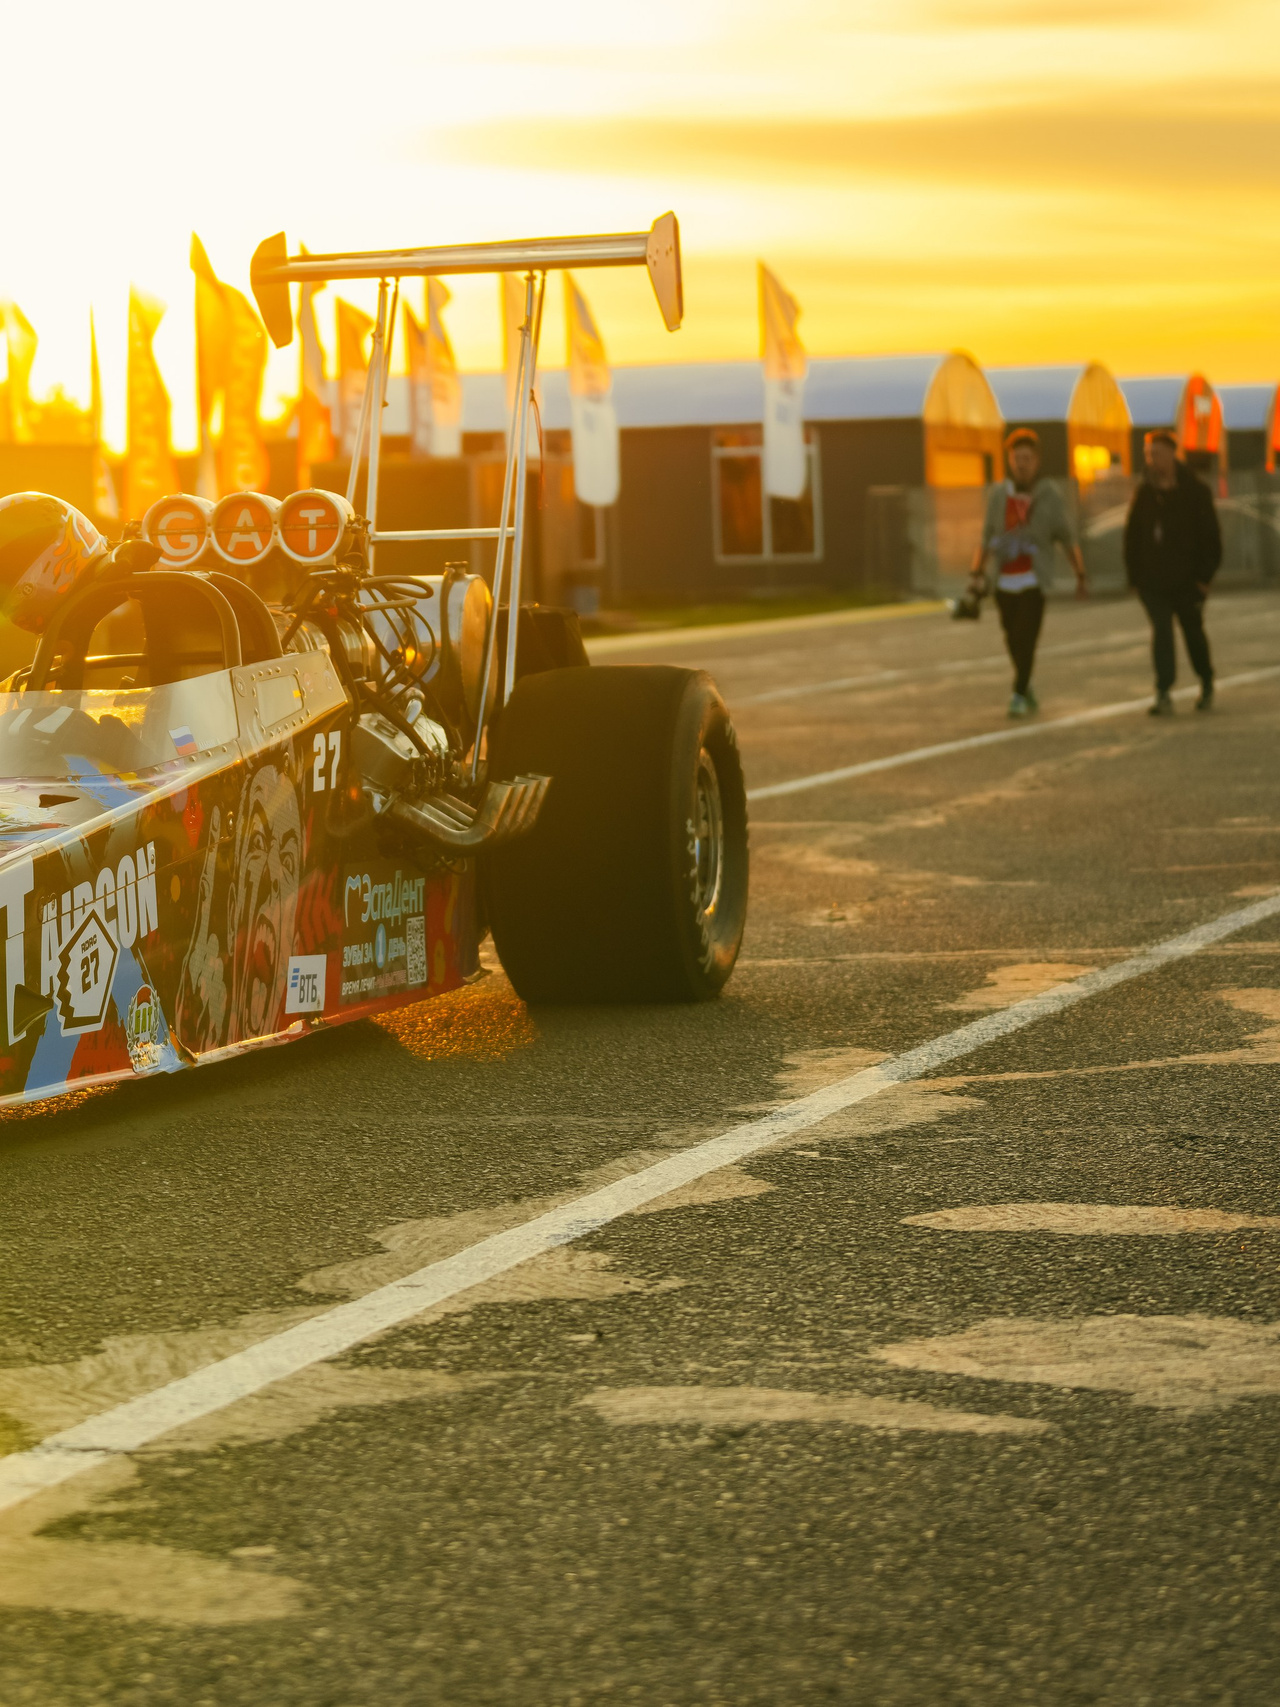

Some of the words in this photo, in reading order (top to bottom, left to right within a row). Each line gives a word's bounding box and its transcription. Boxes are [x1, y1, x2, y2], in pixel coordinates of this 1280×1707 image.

[157, 508, 326, 557] GAT
[313, 730, 341, 792] 27
[80, 947, 100, 995] 27
[364, 942, 374, 964] ЗА
[299, 973, 317, 1004] ВТБ
